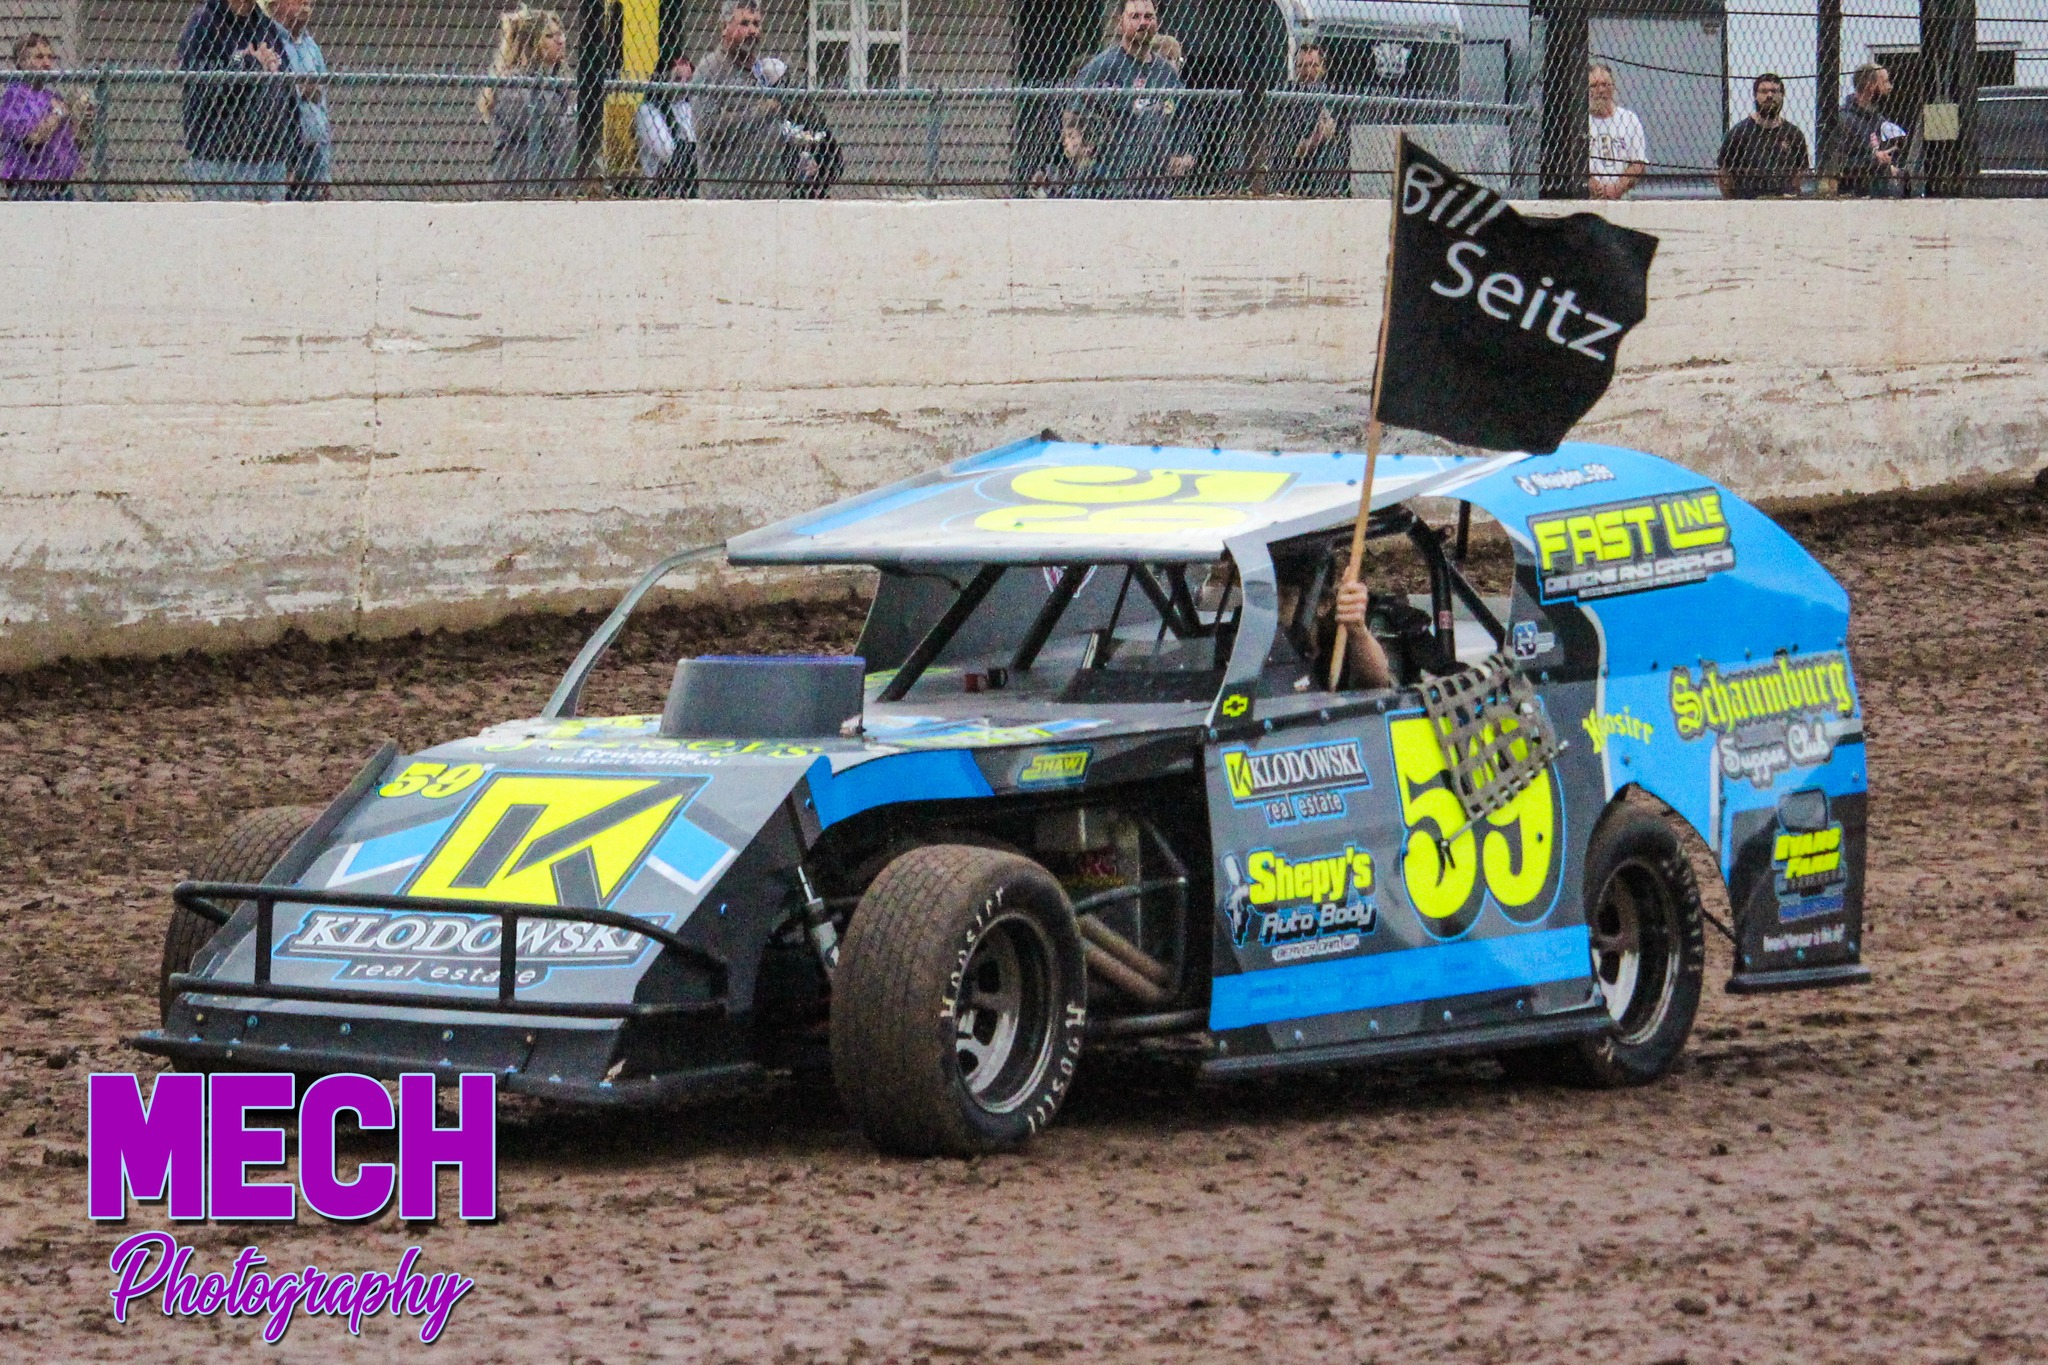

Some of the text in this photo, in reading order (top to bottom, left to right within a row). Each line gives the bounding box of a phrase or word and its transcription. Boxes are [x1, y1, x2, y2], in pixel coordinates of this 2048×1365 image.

[1403, 162, 1508, 236] Bill
[1430, 241, 1622, 361] Seitz
[1533, 494, 1726, 571] FAST LINE
[1672, 657, 1853, 734] Schaumburg
[379, 762, 486, 799] 59
[1249, 743, 1364, 789] KLODOWSKI
[1266, 792, 1343, 820] real estate
[1390, 716, 1554, 919] 59
[1248, 846, 1373, 905] Shepy's
[295, 915, 659, 954] KLODOWSKI
[1262, 900, 1373, 937] Auto Body
[351, 961, 536, 984] real estae
